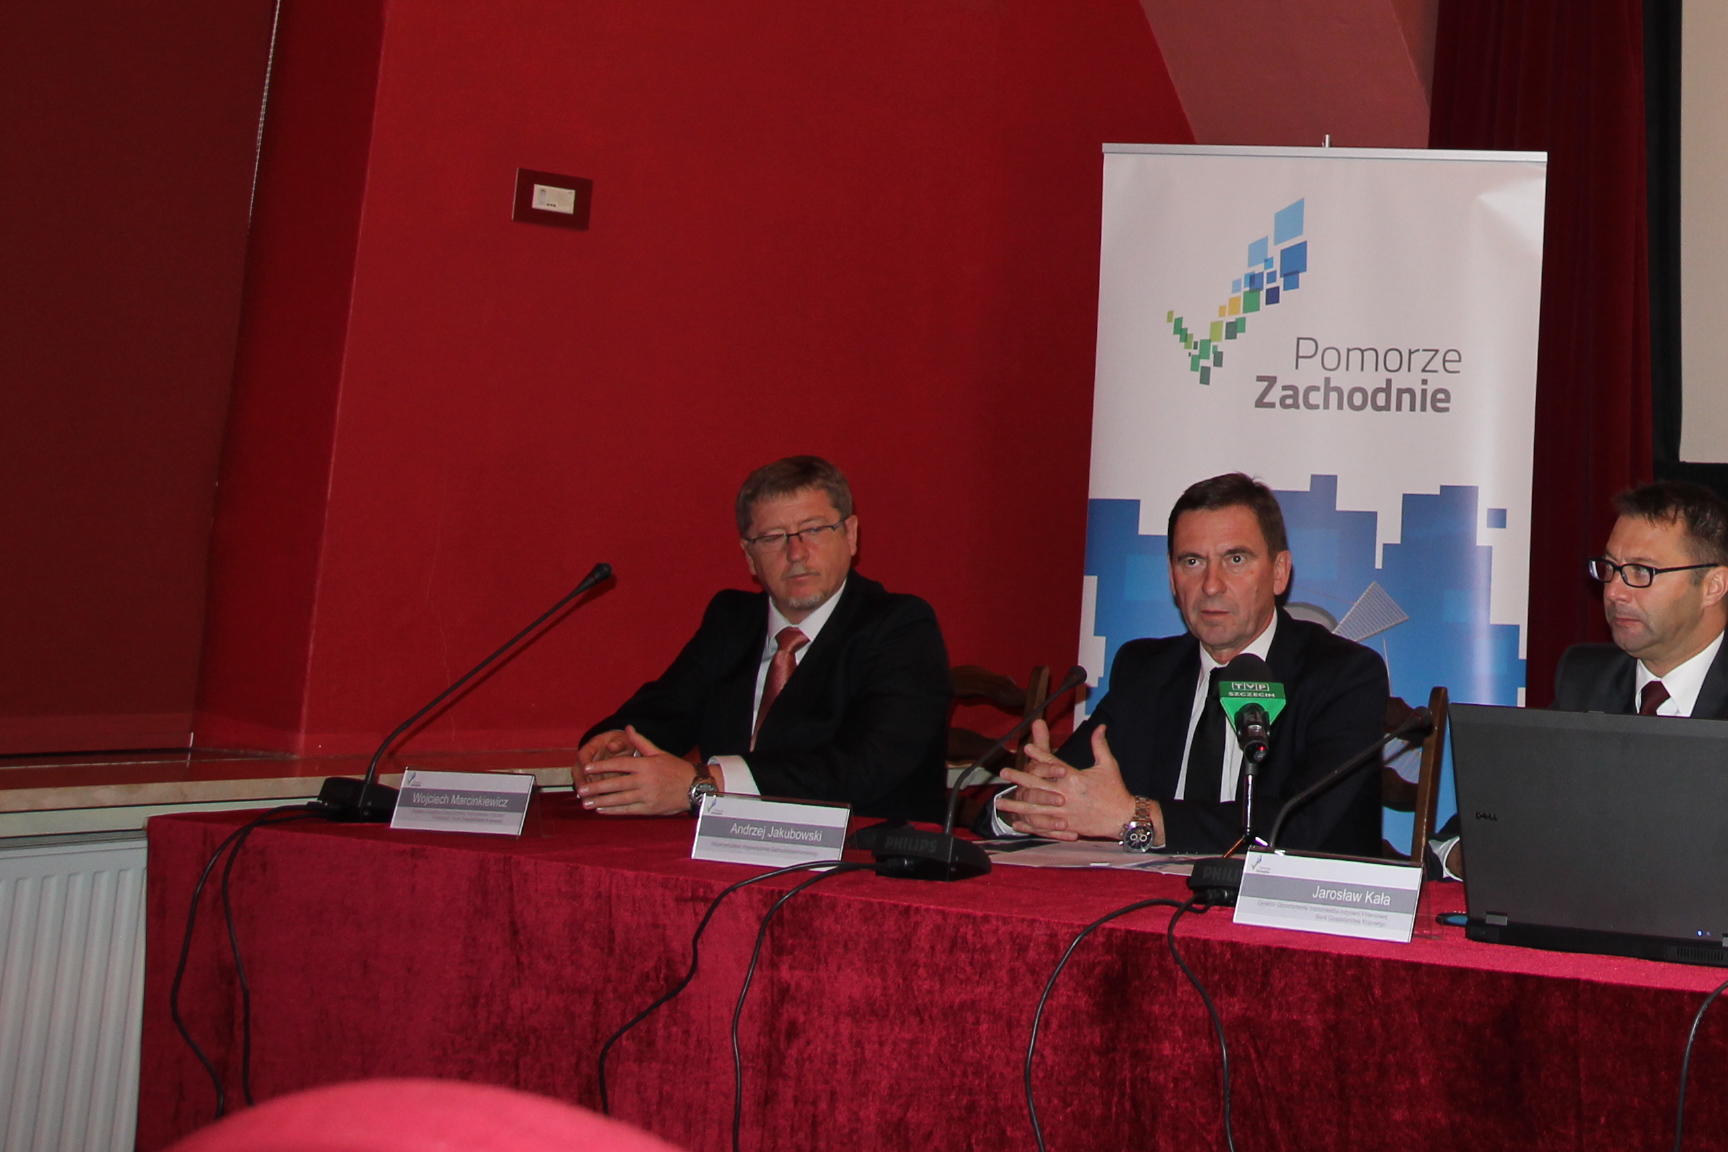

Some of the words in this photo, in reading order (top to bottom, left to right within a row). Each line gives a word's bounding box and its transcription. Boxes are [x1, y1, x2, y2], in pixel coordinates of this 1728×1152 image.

[1294, 336, 1462, 374] Pomorze
[1254, 375, 1451, 413] Zachodnie
[1233, 682, 1268, 690] TVP
[412, 792, 449, 806] Wojciech
[450, 794, 509, 807] Marcinkiewicz
[1475, 811, 1498, 821] DELL
[730, 822, 766, 839] Andrzej
[768, 825, 823, 842] Jakubowski
[1312, 885, 1363, 903] Jarosław
[1364, 891, 1391, 906] Kała
